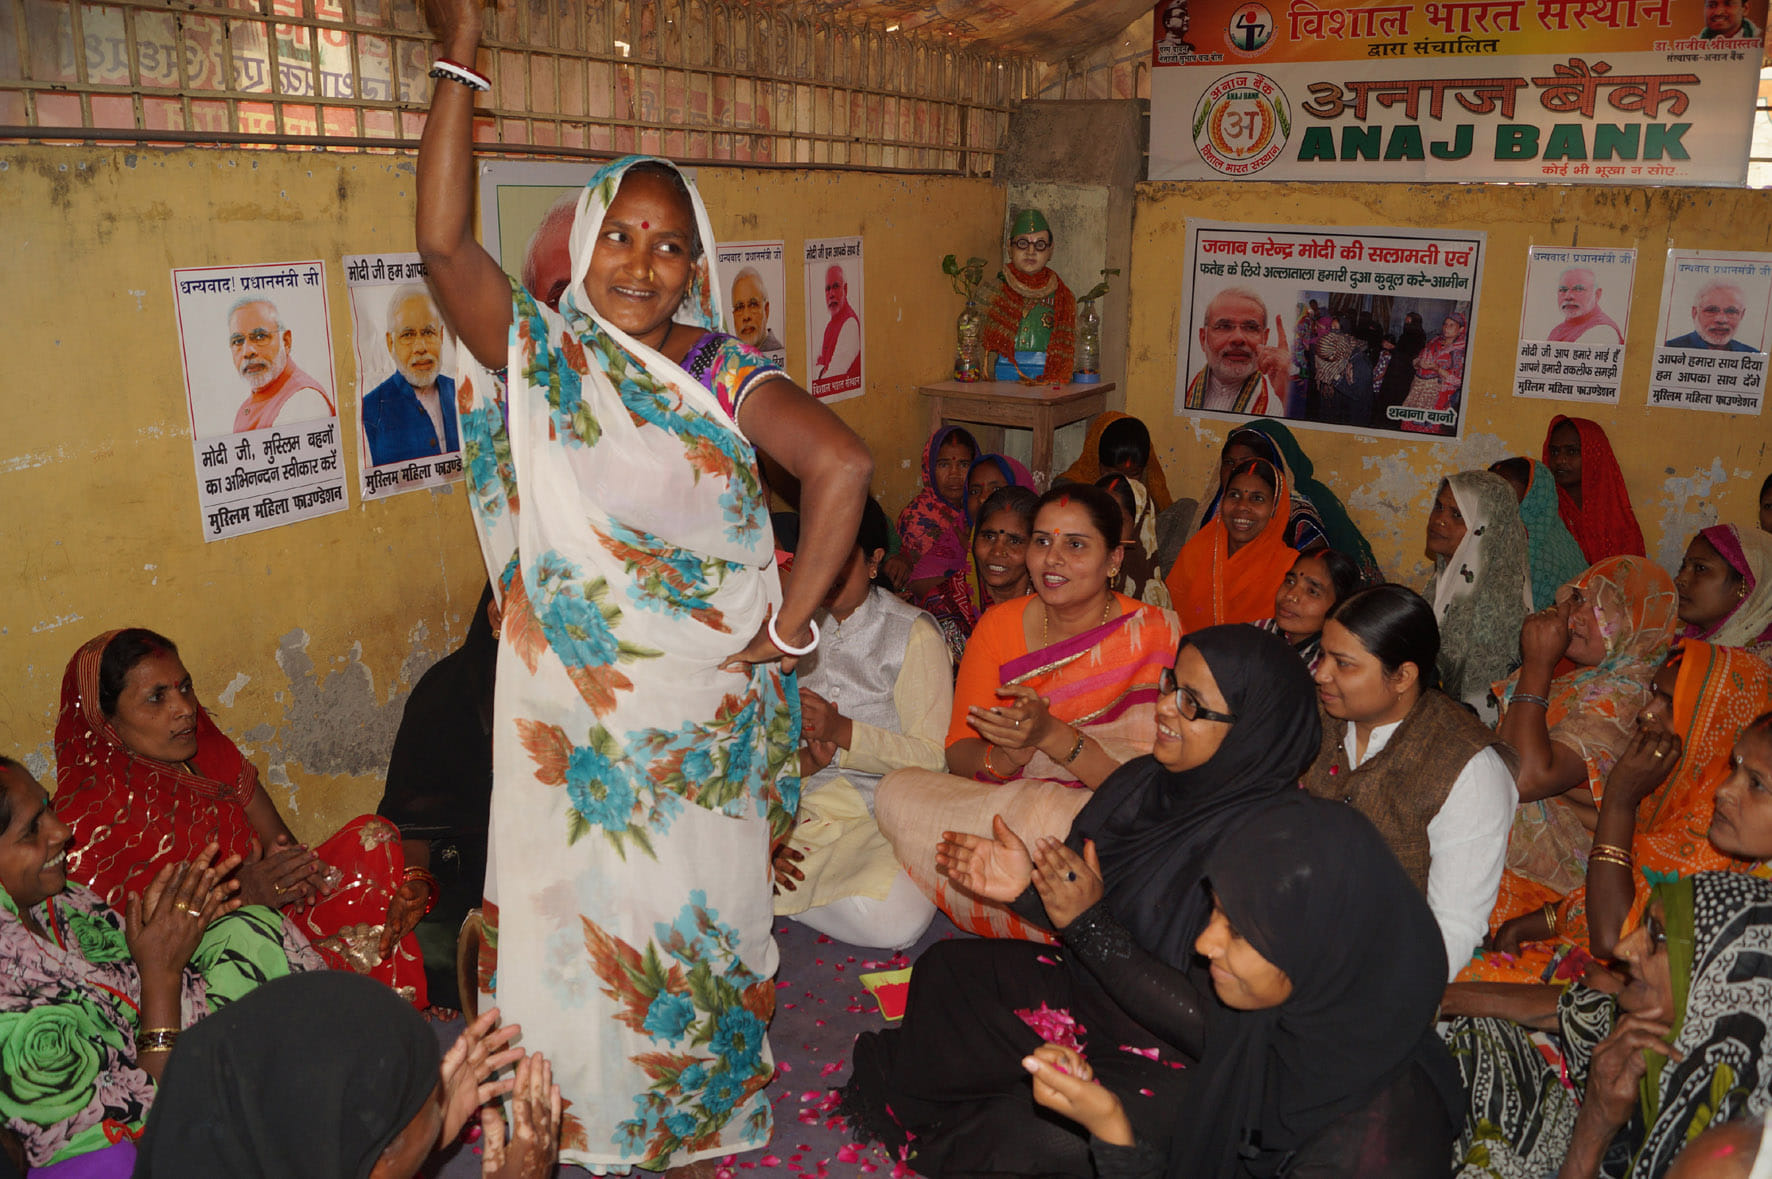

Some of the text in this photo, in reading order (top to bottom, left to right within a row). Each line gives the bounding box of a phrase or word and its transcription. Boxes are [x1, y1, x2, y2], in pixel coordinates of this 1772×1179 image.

[1288, 1, 1413, 41] विशाल
[1425, 0, 1527, 34] भारत
[1367, 36, 1500, 56] द्वारा संचालित
[1675, 38, 1706, 51] राजीव
[1708, 36, 1760, 50] श्रीवास्तव
[1210, 74, 1275, 100] अनाज बैंक
[1302, 58, 1703, 121] अनाज बैंक
[1297, 122, 1693, 162] ANAJ BANK
[1200, 143, 1280, 173] विशाल भारत संस्थान
[1542, 162, 1569, 176] कोई
[1573, 162, 1589, 175] भी
[1595, 165, 1626, 178] भूखा
[1631, 166, 1643, 175] न
[1202, 237, 1473, 267] जनाब नरेन्द्र मोदी की सलामती एवं
[1573, 252, 1616, 264] प्रधानमंत्री
[1620, 252, 1632, 264] जी
[180, 267, 319, 294] धन्यवाद! प्रधानमंत्री जी
[348, 259, 369, 281] मोदी
[371, 258, 385, 280] जी
[387, 264, 403, 280] हम
[1200, 261, 1224, 277] फतेह
[1227, 261, 1238, 276] के
[1241, 260, 1261, 278] लिये
[1263, 265, 1315, 281] अल्लाताला
[1318, 265, 1347, 284] हमारी
[1350, 269, 1371, 288] दुआ
[1374, 273, 1404, 291] कुबूल
[1521, 344, 1538, 357] मोदी
[1540, 344, 1552, 358] जी
[1554, 348, 1570, 359] आप
[1572, 347, 1591, 361] हमारे
[1594, 347, 1610, 362] भाई
[1657, 352, 1764, 371] आपने हमारा साथ दिया
[1519, 360, 1618, 379] आपने हमारी तकलीफ समझी
[1655, 370, 1761, 388] हम आपका साथ देंगे
[1518, 379, 1617, 398] मुस्लिम महिला फाउण्डेशन
[1652, 388, 1758, 408] मुस्लिम महिला फाउण्डेशन
[1388, 406, 1455, 424] शबाना बानो
[202, 442, 228, 468] मोदी
[234, 438, 256, 461] जी,
[263, 432, 301, 464] मुस्लिम
[205, 449, 337, 496] का अभिनन्दन स्वीकार करें
[365, 456, 463, 495] मुस्लिम महिला फाउण्डे
[208, 485, 342, 534] मुस्लिम महिला फाउण्डेशन
